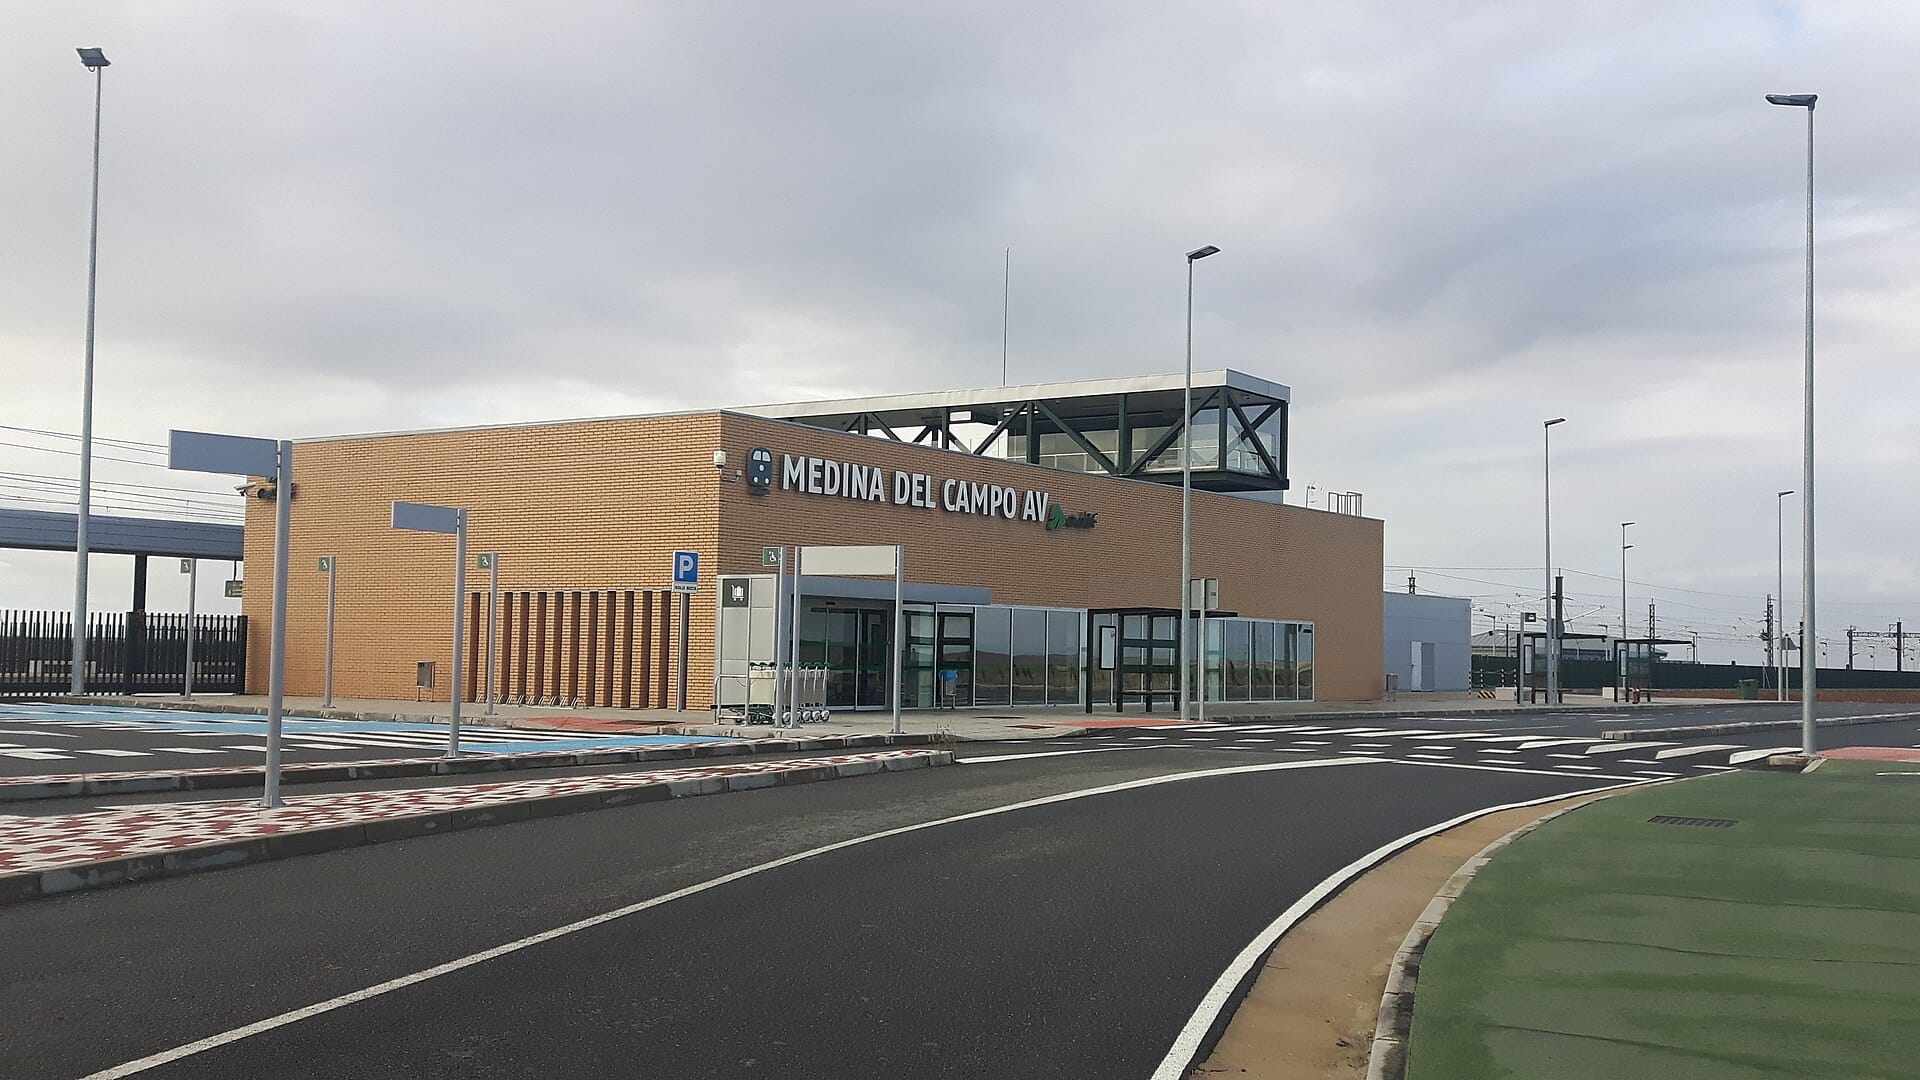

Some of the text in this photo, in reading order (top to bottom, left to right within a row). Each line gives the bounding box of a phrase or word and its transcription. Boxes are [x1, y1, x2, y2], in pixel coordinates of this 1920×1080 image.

[782, 453, 886, 502] MEDINA
[894, 470, 937, 508] DEL
[943, 478, 1017, 519] CAMPO
[1022, 490, 1049, 522] AV
[679, 554, 694, 579] P
